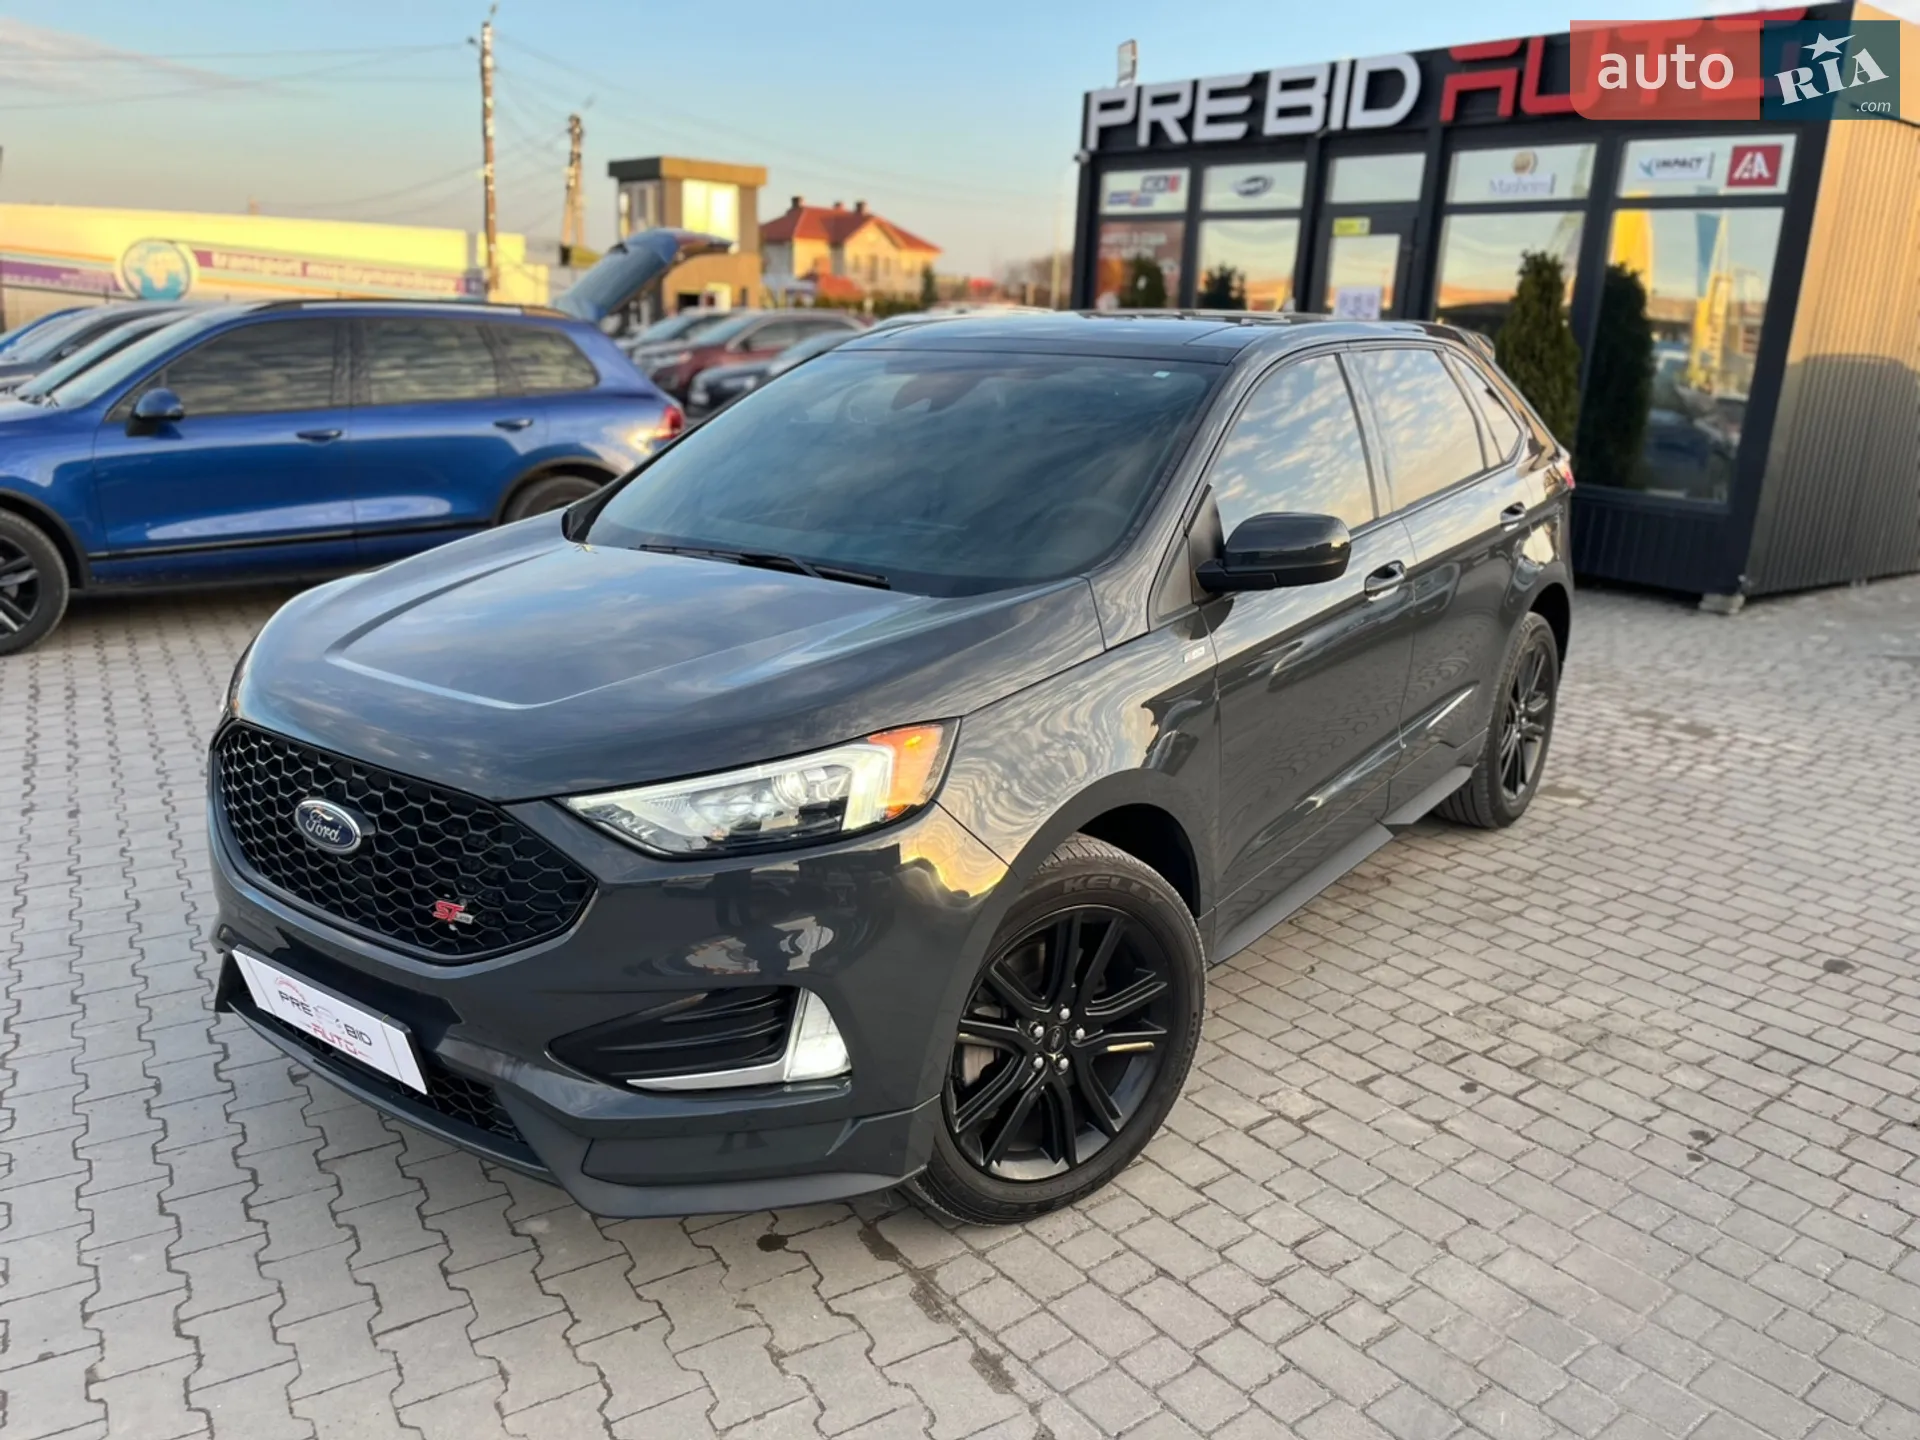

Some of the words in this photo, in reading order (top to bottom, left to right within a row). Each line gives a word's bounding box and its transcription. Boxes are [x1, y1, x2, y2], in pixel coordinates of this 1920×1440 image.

[1088, 73, 1253, 150] PRE
[1263, 54, 1421, 136] BID
[306, 808, 341, 843] Ford
[1063, 874, 1164, 904] KELLY
[433, 901, 464, 922] ST
[278, 990, 314, 1017] PRE
[344, 1024, 372, 1046] BID
